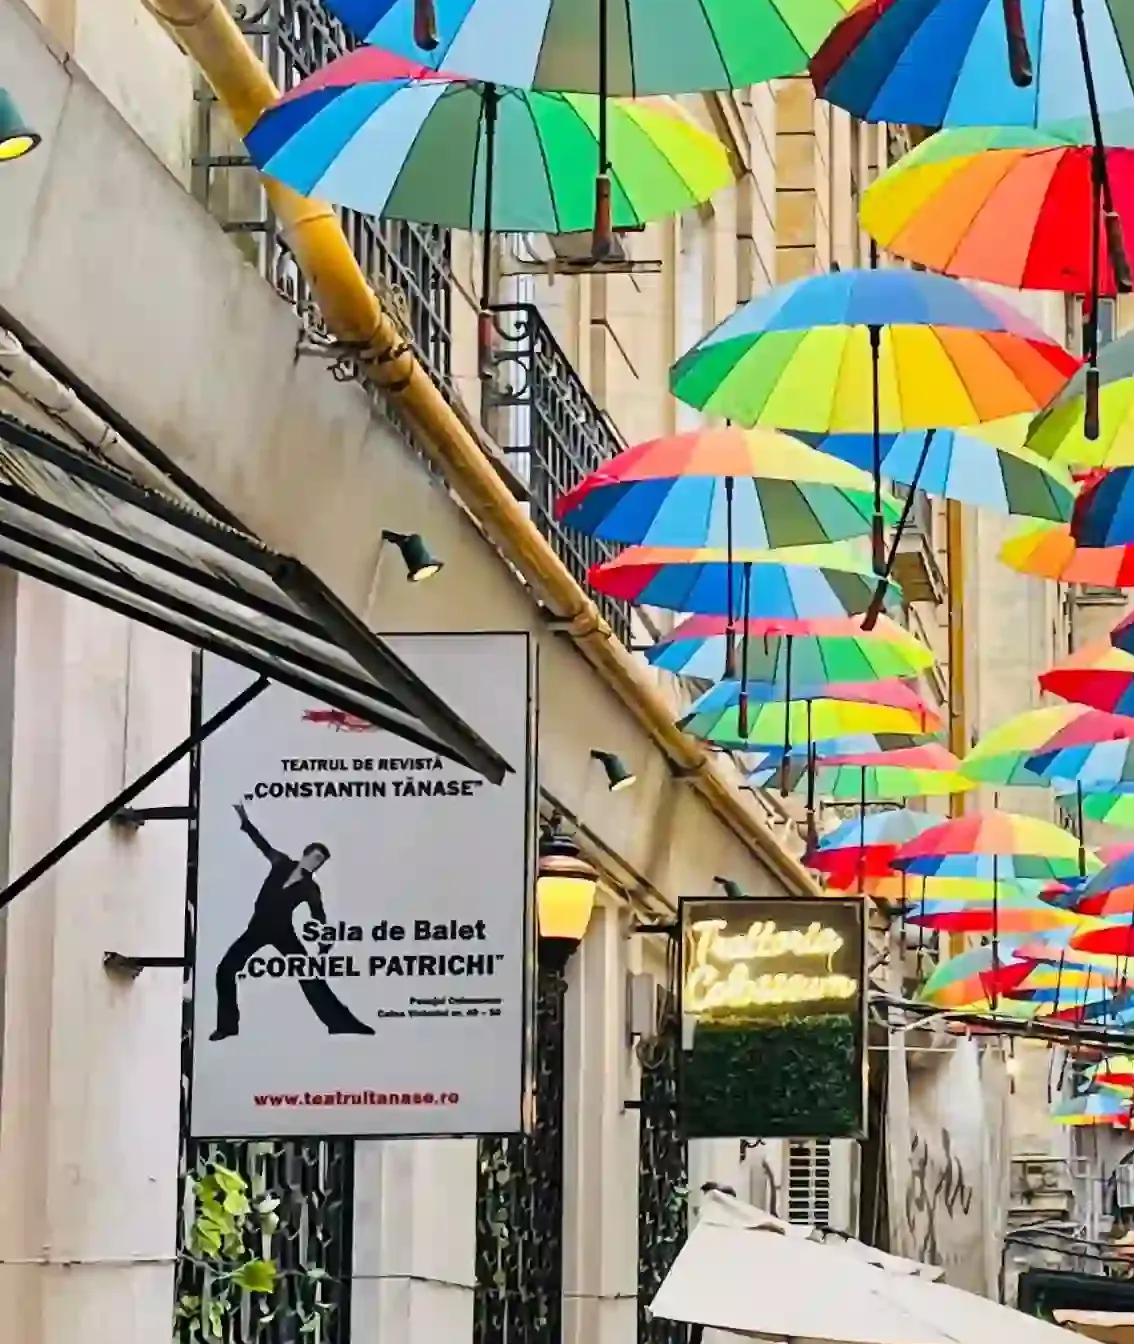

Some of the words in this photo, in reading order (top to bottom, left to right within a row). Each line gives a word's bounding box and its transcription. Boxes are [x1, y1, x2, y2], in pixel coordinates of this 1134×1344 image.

[281, 758, 348, 771] TEATRUL
[352, 758, 373, 771] DE
[302, 921, 363, 942] Sala
[371, 920, 405, 941] de
[414, 920, 486, 941] Balet
[253, 1090, 460, 1106] www.teatrultanase.ro
